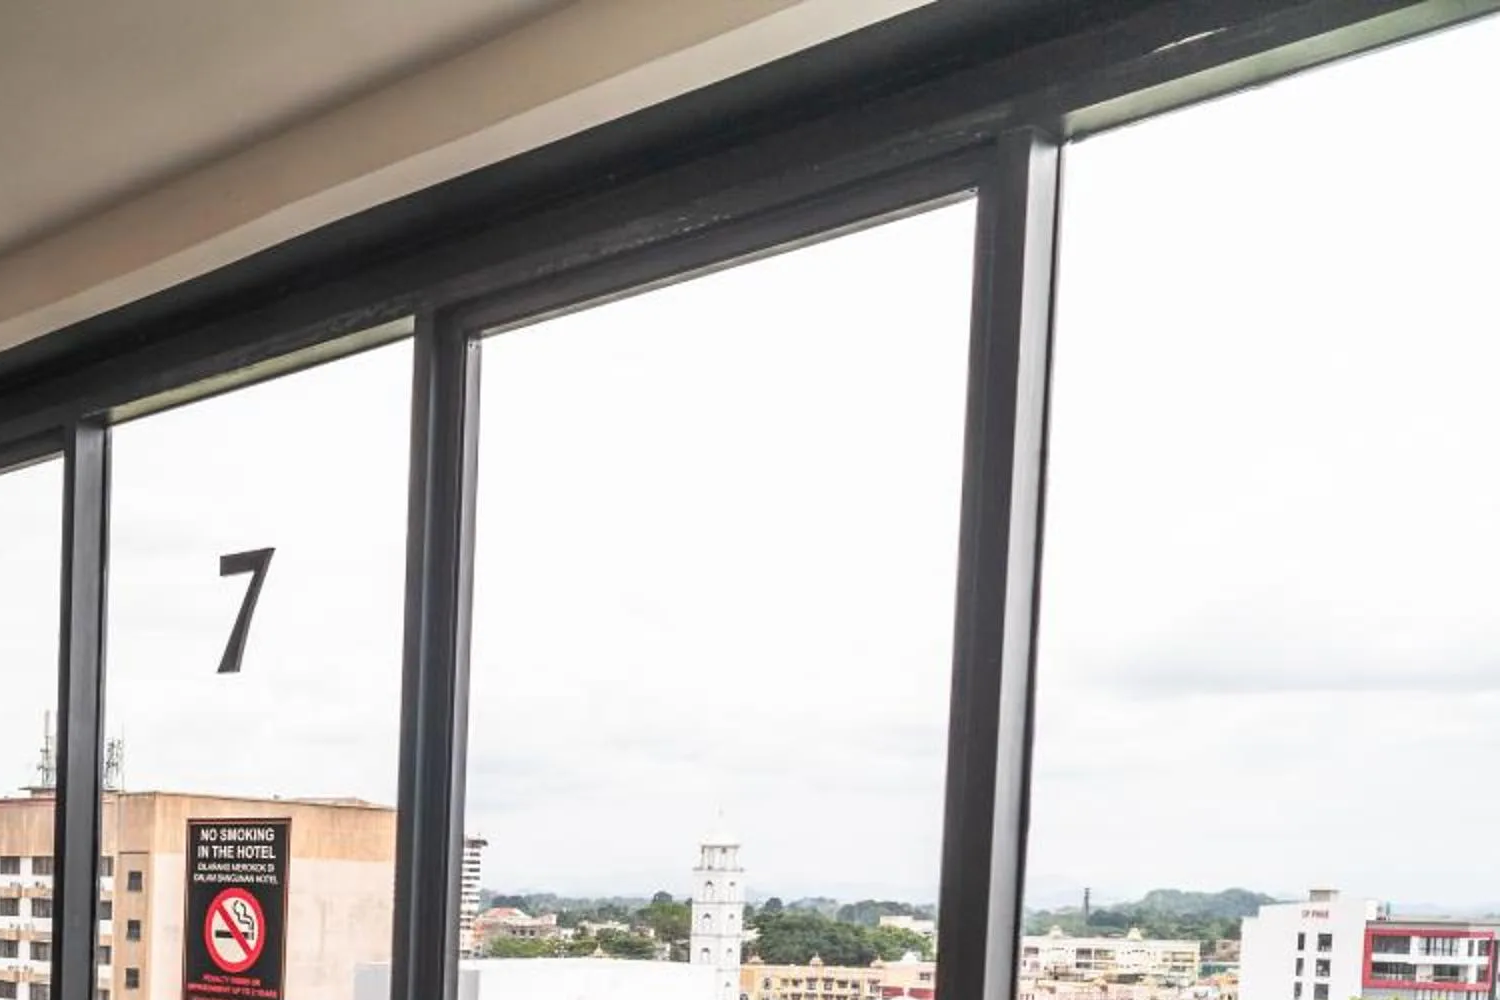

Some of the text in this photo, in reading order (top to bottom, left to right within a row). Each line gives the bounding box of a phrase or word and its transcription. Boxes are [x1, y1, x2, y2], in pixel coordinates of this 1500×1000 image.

[216, 546, 276, 673] 7
[200, 827, 275, 842] NO SMOKING
[197, 845, 276, 859] IN THE HOTEL
